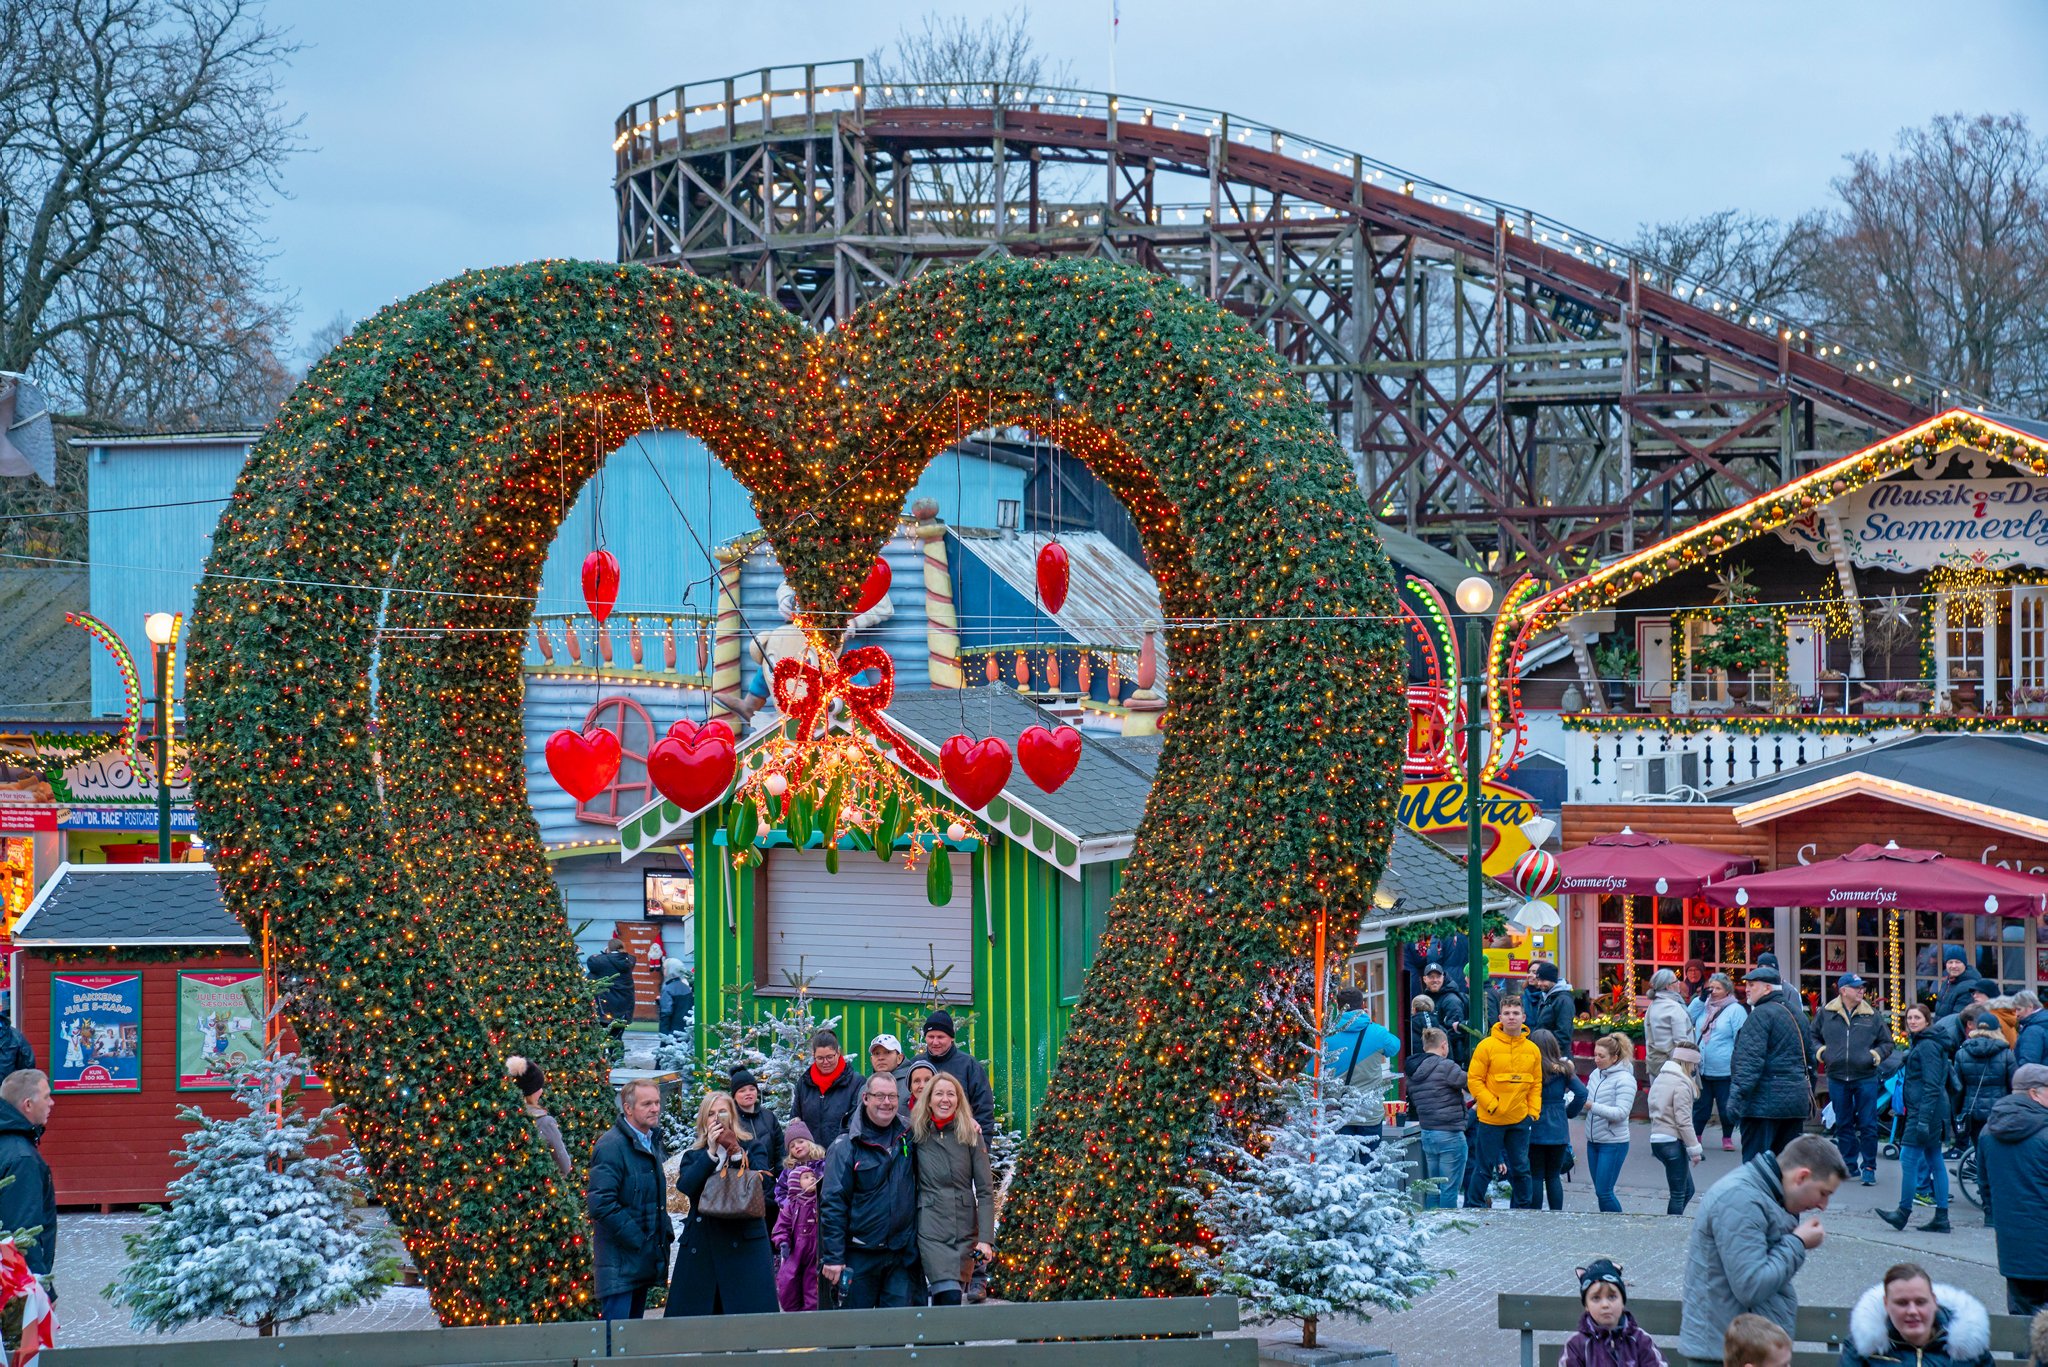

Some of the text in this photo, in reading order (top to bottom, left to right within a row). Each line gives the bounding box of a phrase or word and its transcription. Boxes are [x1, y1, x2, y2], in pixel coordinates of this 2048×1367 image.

[1868, 484, 1974, 509] Musik
[101, 811, 123, 825] FACE"
[124, 811, 154, 826] POSTCARD
[1562, 875, 1628, 892] Sommerlyst
[1827, 887, 1898, 905] Sommerlyst
[73, 992, 123, 1004] BAKKENS
[196, 992, 246, 1001] JULETILBU
[64, 1002, 133, 1016] JULE 5-KAMP
